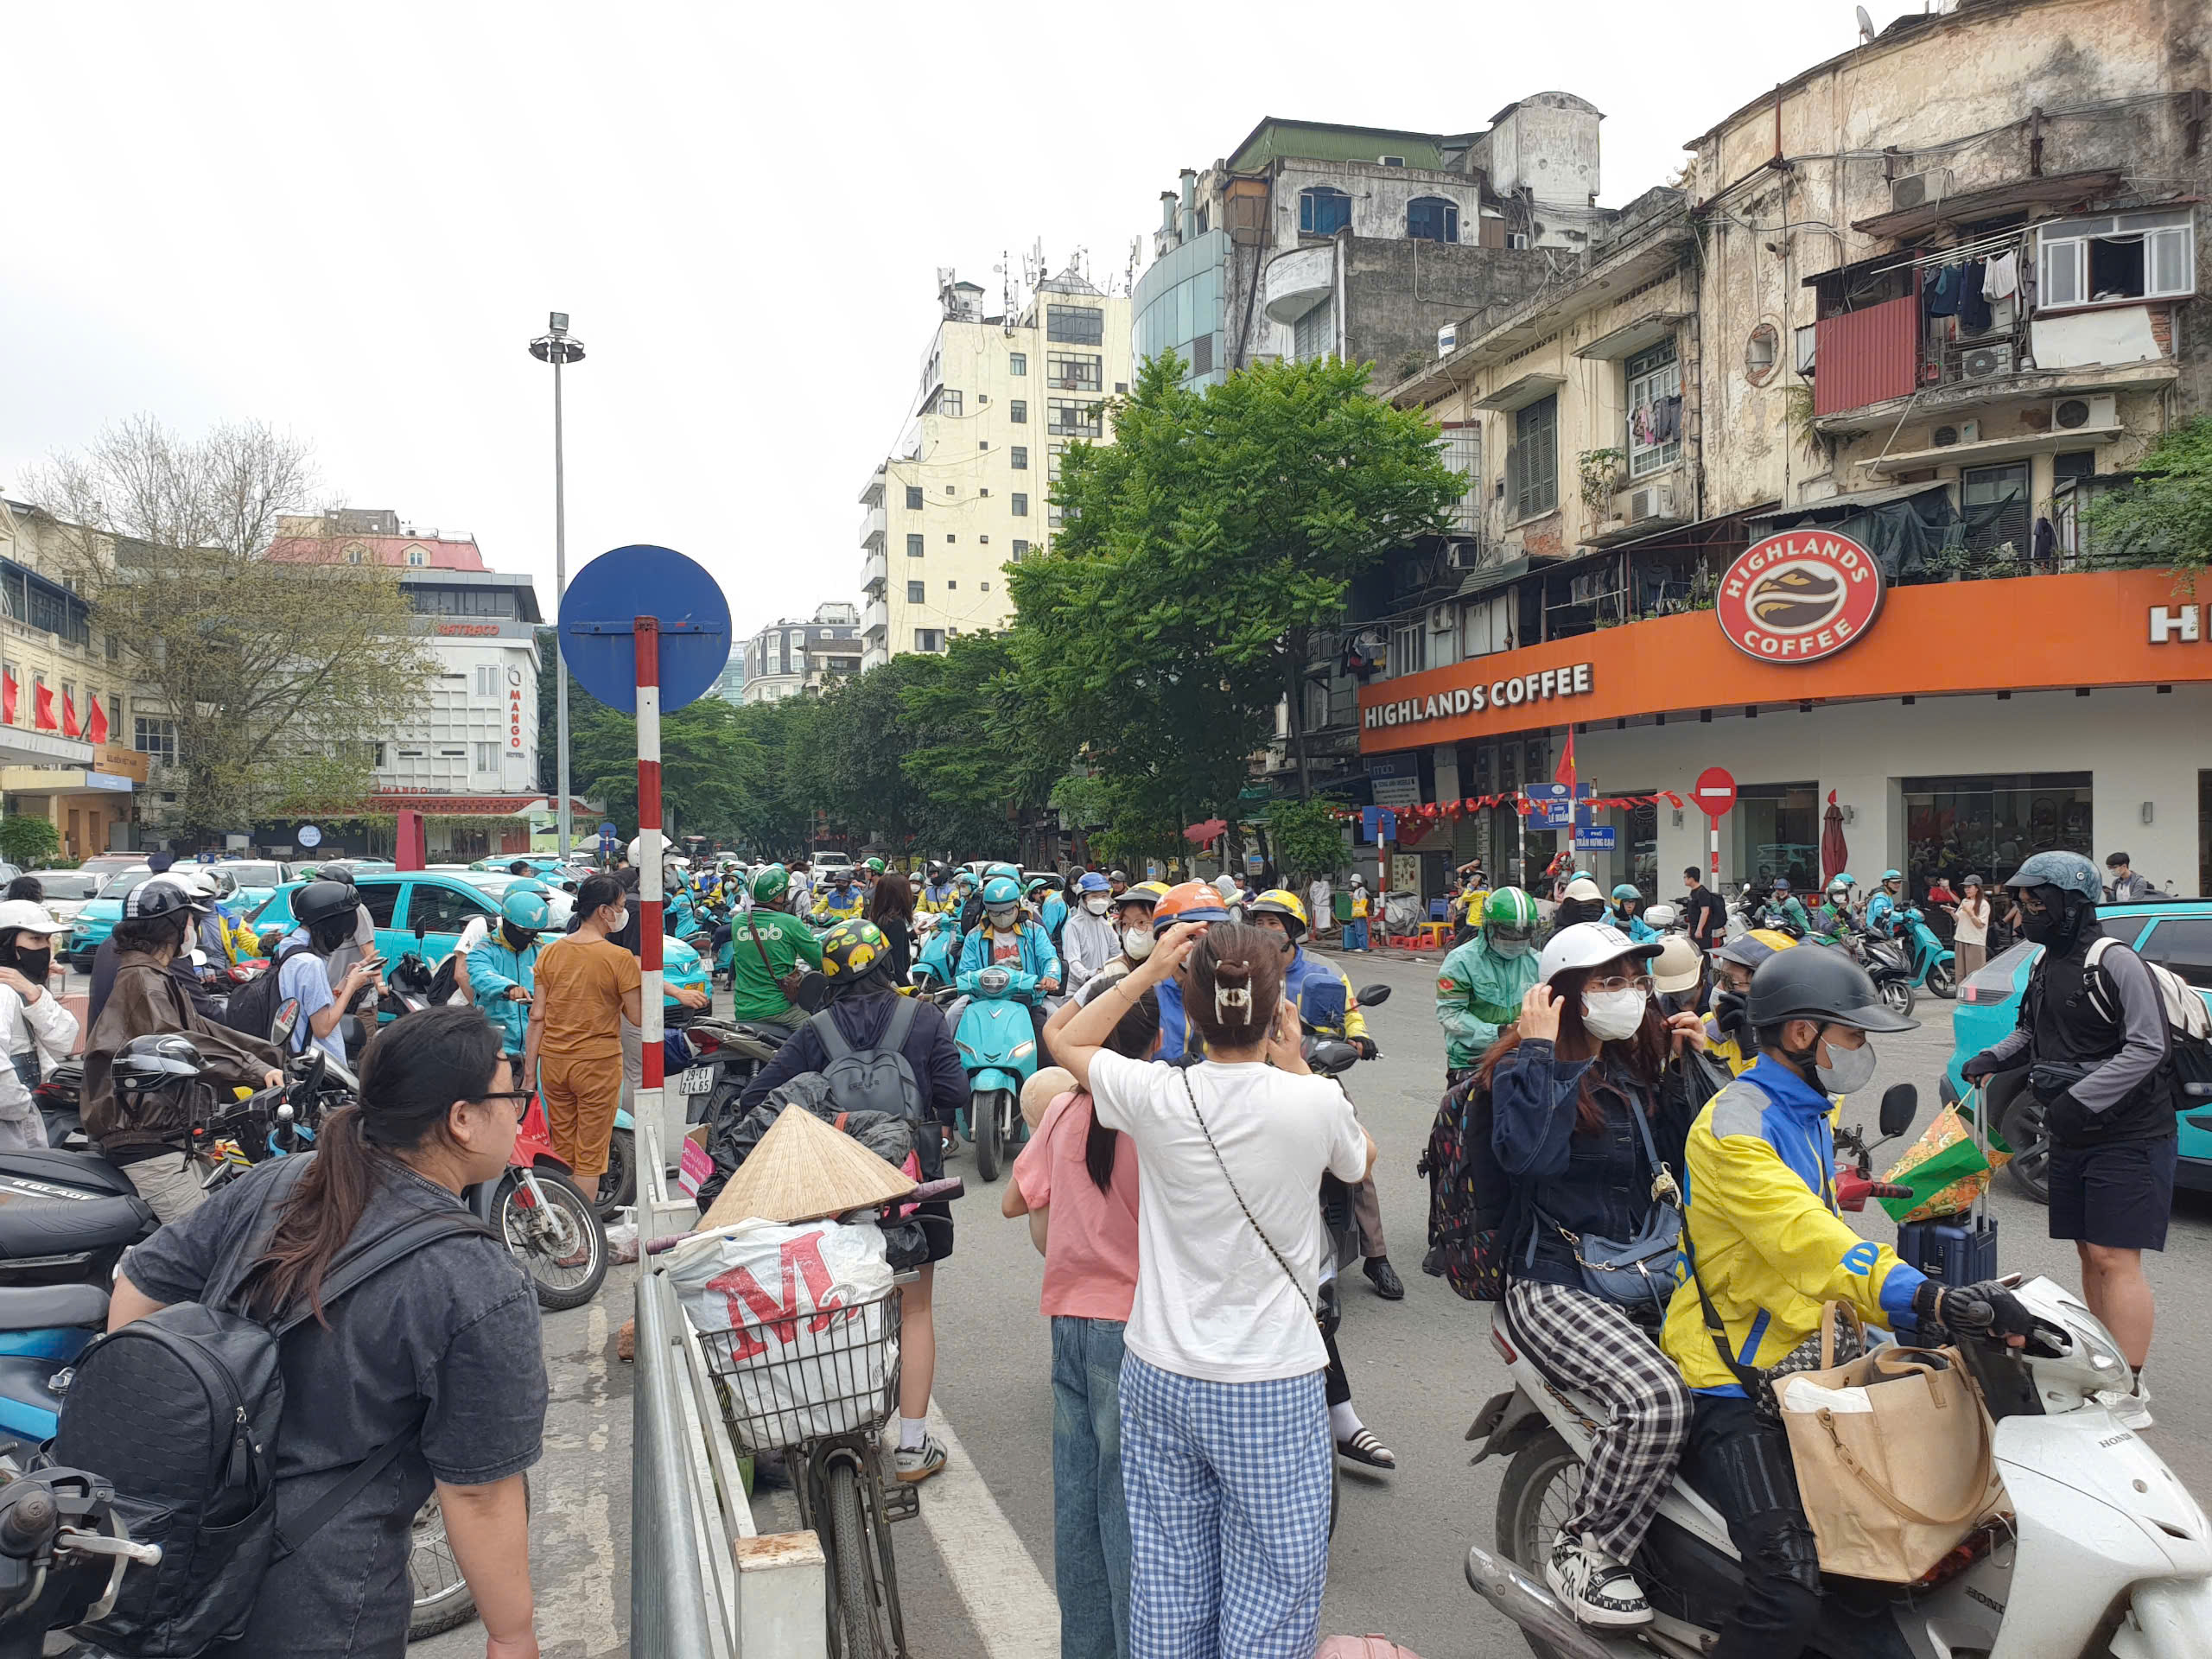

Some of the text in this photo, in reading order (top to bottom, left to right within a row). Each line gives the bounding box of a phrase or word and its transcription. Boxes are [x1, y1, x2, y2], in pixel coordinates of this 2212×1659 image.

[1726, 537, 1869, 599] HIGHLANDS
[1744, 618, 1853, 656] COFFEE
[1364, 663, 1592, 728] HIGHLANDS COFFEE
[510, 690, 521, 747] MANGO
[767, 882, 785, 896] Grab
[737, 922, 783, 942] Grab
[682, 1079, 709, 1094] 214.65
